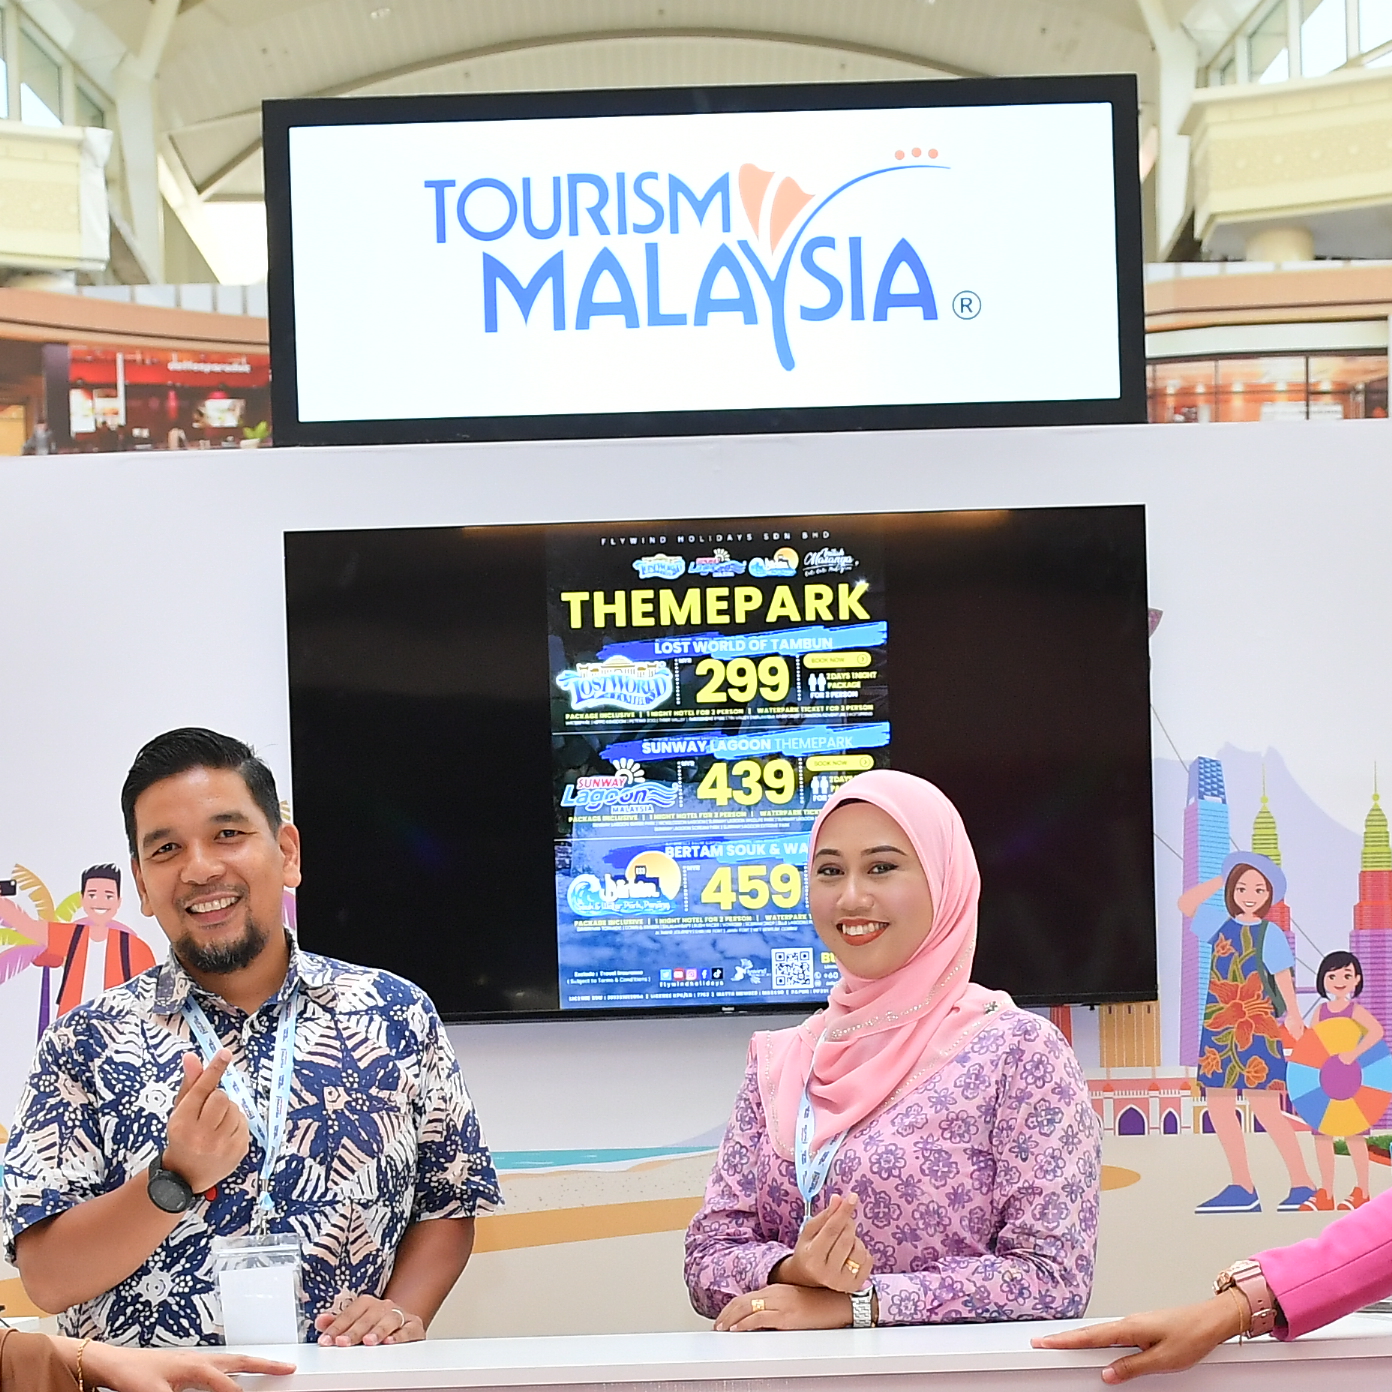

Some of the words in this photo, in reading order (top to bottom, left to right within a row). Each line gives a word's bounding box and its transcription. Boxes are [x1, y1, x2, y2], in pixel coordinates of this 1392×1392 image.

[423, 170, 732, 244] TOURISM
[481, 222, 939, 371] MALAYSIA
[600, 536, 667, 546] FLYWIND
[677, 533, 754, 544] HOLIDAYS
[763, 532, 792, 541] SDN
[801, 530, 830, 540] BHD
[560, 582, 872, 629] THEMEPARK
[654, 642, 690, 655] LOST
[693, 640, 745, 653] WORLD
[748, 639, 768, 651] OF
[770, 637, 833, 651] TAMBUN
[695, 655, 790, 703] 299
[641, 741, 706, 754] SUNWAY
[709, 739, 772, 751] LAGOON
[774, 736, 854, 749] THEMEPARK
[577, 777, 626, 789] SUNWAY
[696, 758, 796, 807] 439
[560, 784, 649, 812] Lagoon
[611, 805, 654, 813] MALAYSIA
[665, 846, 723, 859] BERTAM
[726, 844, 767, 857] SOUK
[770, 843, 780, 854] &
[700, 863, 803, 911] 459
